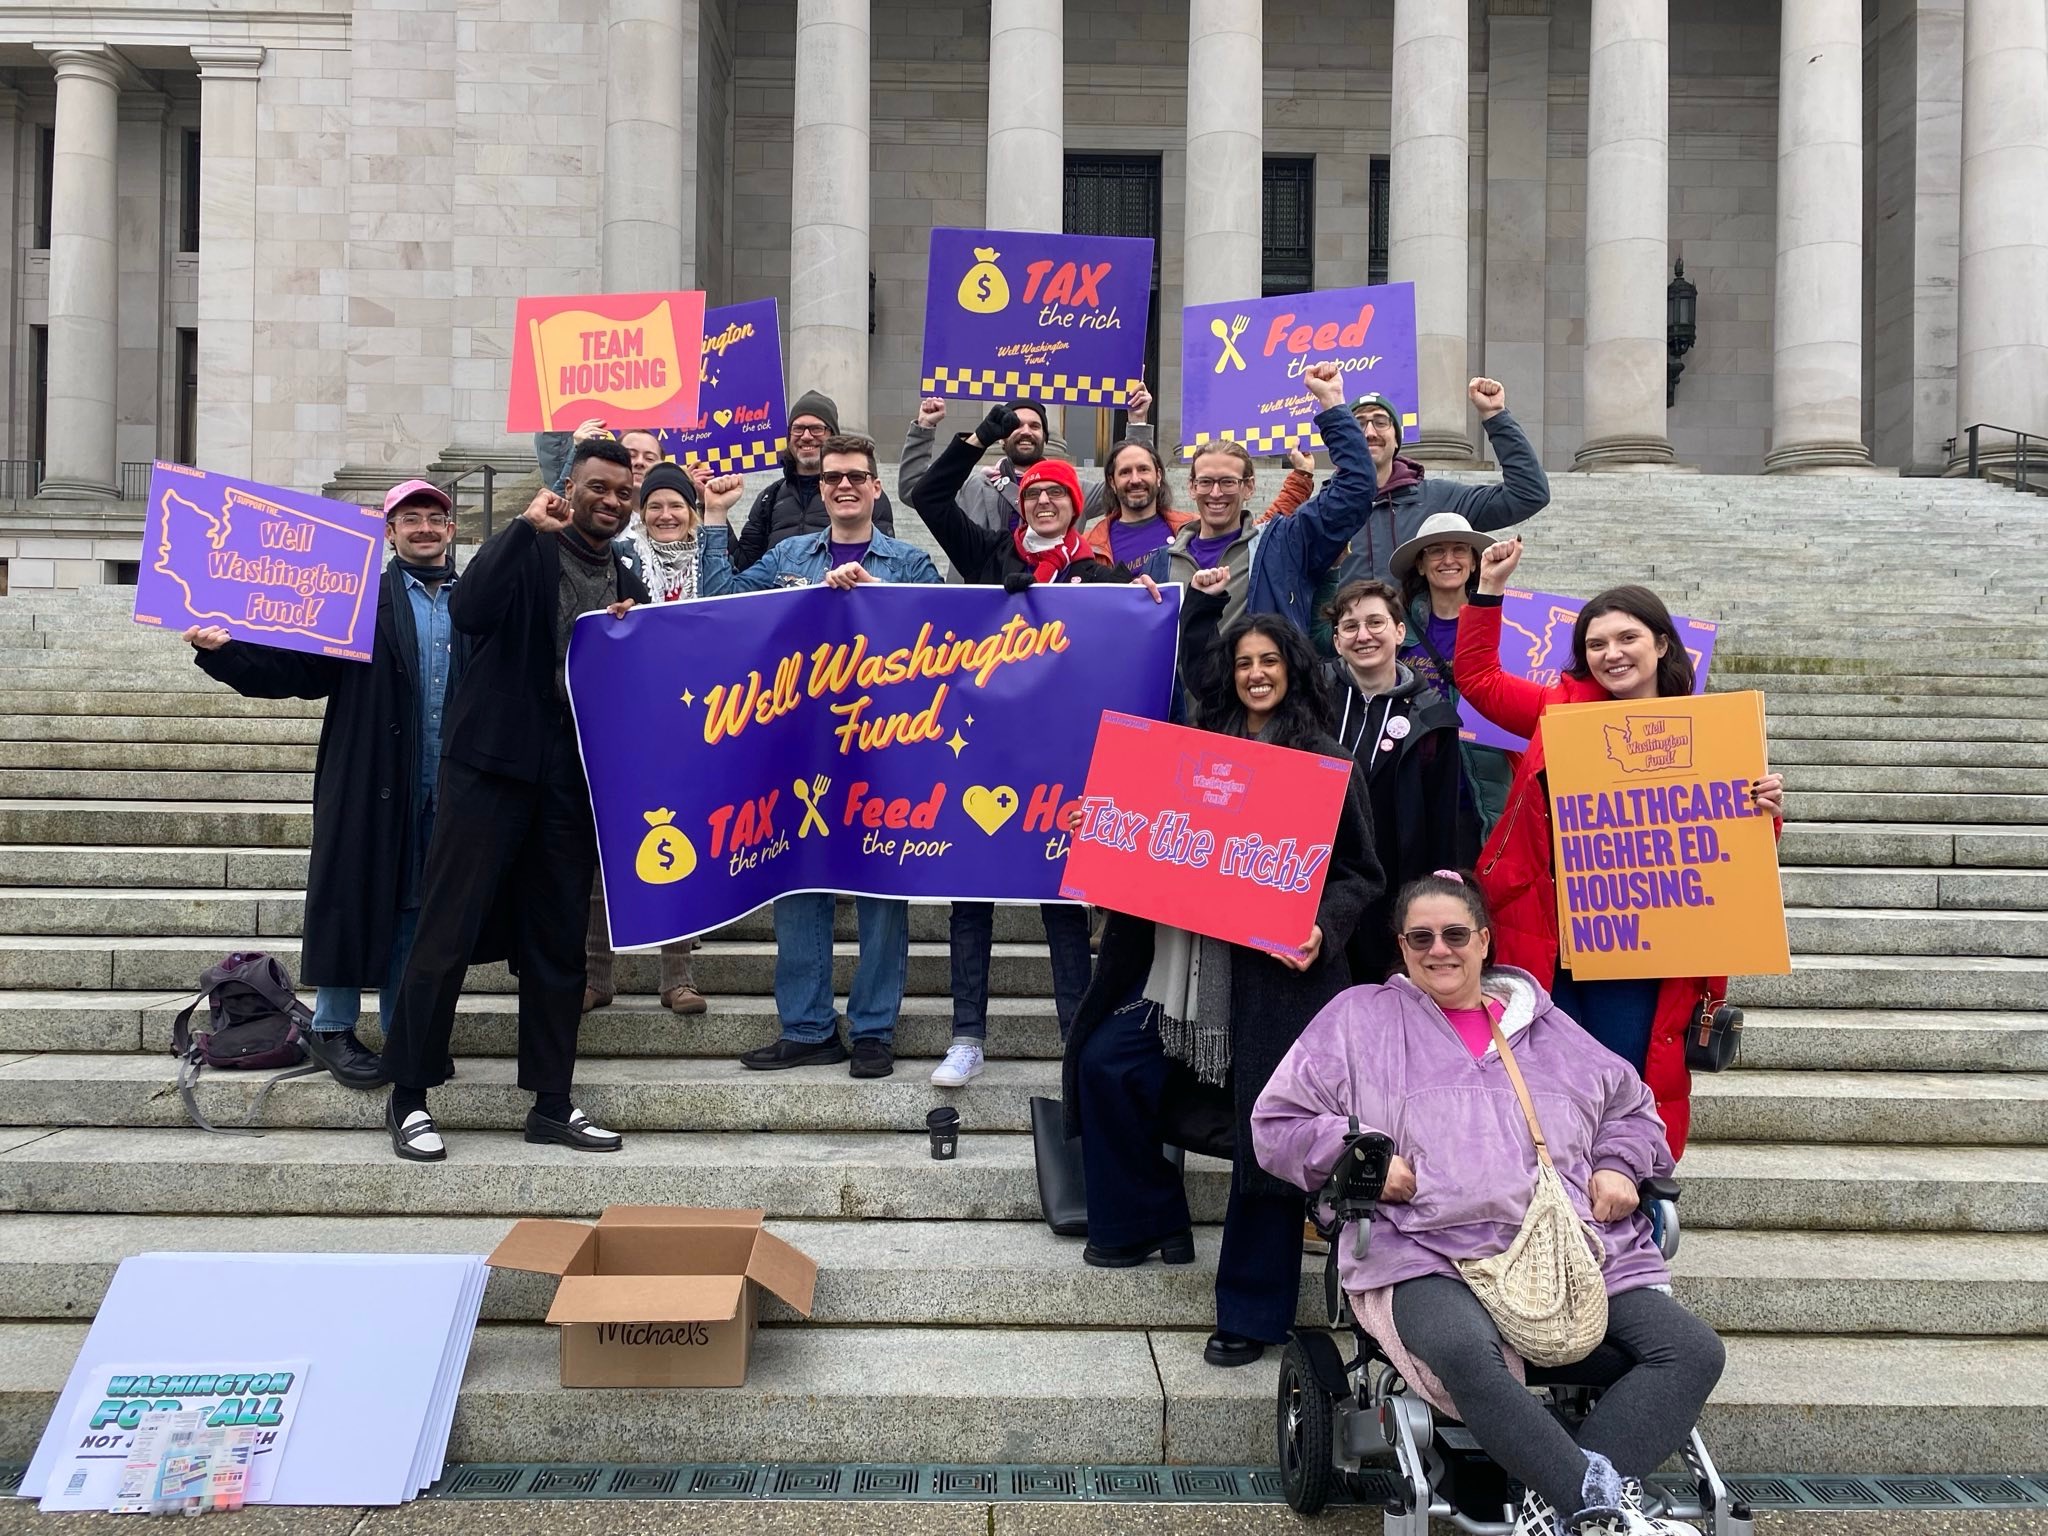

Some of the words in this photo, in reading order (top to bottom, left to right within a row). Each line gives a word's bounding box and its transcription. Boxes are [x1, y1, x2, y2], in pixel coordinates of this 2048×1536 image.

[1022, 260, 1112, 308] TAX
[1038, 302, 1072, 328] the
[1079, 306, 1121, 330] rich
[1263, 303, 1375, 357] Feed
[579, 327, 643, 361] TEAM
[702, 322, 755, 357] ington
[997, 345, 1020, 358] Well
[1020, 340, 1070, 355] Washington
[560, 357, 667, 395] HOUSING
[1024, 353, 1046, 365] Fund
[734, 401, 770, 424] Heal
[1259, 400, 1283, 415] Well
[1284, 392, 1320, 408] Washin
[1289, 403, 1312, 417] Fund
[681, 432, 694, 442] the
[695, 431, 712, 443] poor
[742, 423, 756, 434] the
[260, 521, 315, 552] Well
[208, 551, 358, 597] Washington
[246, 592, 325, 627] Fund!
[703, 651, 803, 746] Well
[807, 614, 1070, 698] Washington
[830, 684, 949, 755] Fund
[1643, 720, 1665, 736] Well
[1627, 735, 1688, 755] Washington
[1646, 750, 1676, 768] Fund!
[843, 782, 947, 829] Feed
[1556, 778, 1763, 832] HEALTHCARE.
[708, 789, 779, 859] TAX
[729, 846, 757, 877] the
[761, 829, 790, 864] rich
[862, 829, 895, 855] the
[900, 839, 952, 865] poor
[1046, 834, 1070, 860] th
[1080, 797, 1148, 851] Tax
[1149, 811, 1214, 867] the
[1220, 834, 1332, 893] rich!
[1561, 831, 1676, 873] HIGHER
[1679, 826, 1731, 864] ED.
[1566, 869, 1714, 912] HOUSING.
[1571, 913, 1651, 953] NOW.
[106, 1372, 295, 1398] WASHINGTON
[206, 1397, 284, 1427] ALL
[80, 1435, 124, 1448] NOT
